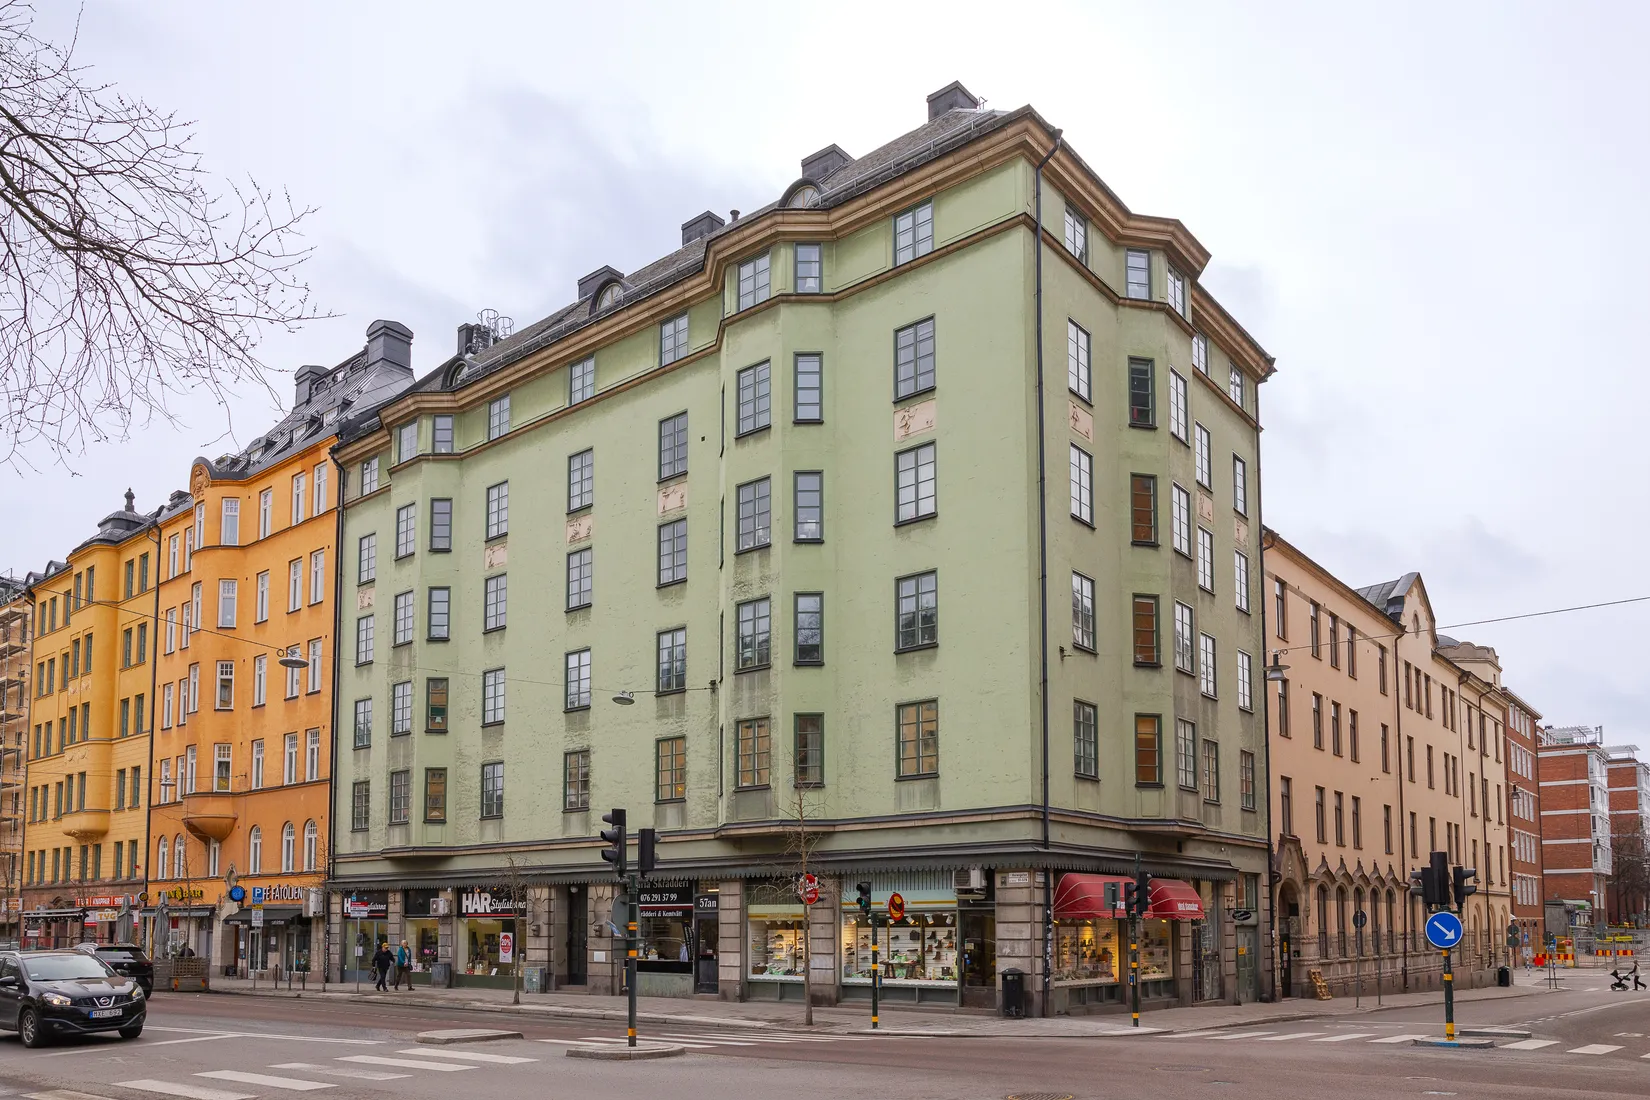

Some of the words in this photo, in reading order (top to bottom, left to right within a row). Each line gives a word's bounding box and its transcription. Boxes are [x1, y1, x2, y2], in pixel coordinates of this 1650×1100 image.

[183, 889, 203, 898] BAR
[651, 893, 661, 902] 291
[662, 893, 669, 902] 37
[670, 893, 678, 901] 99
[461, 887, 491, 913] HÅR
[699, 898, 717, 908] 57an
[97, 912, 116, 920] TYG
